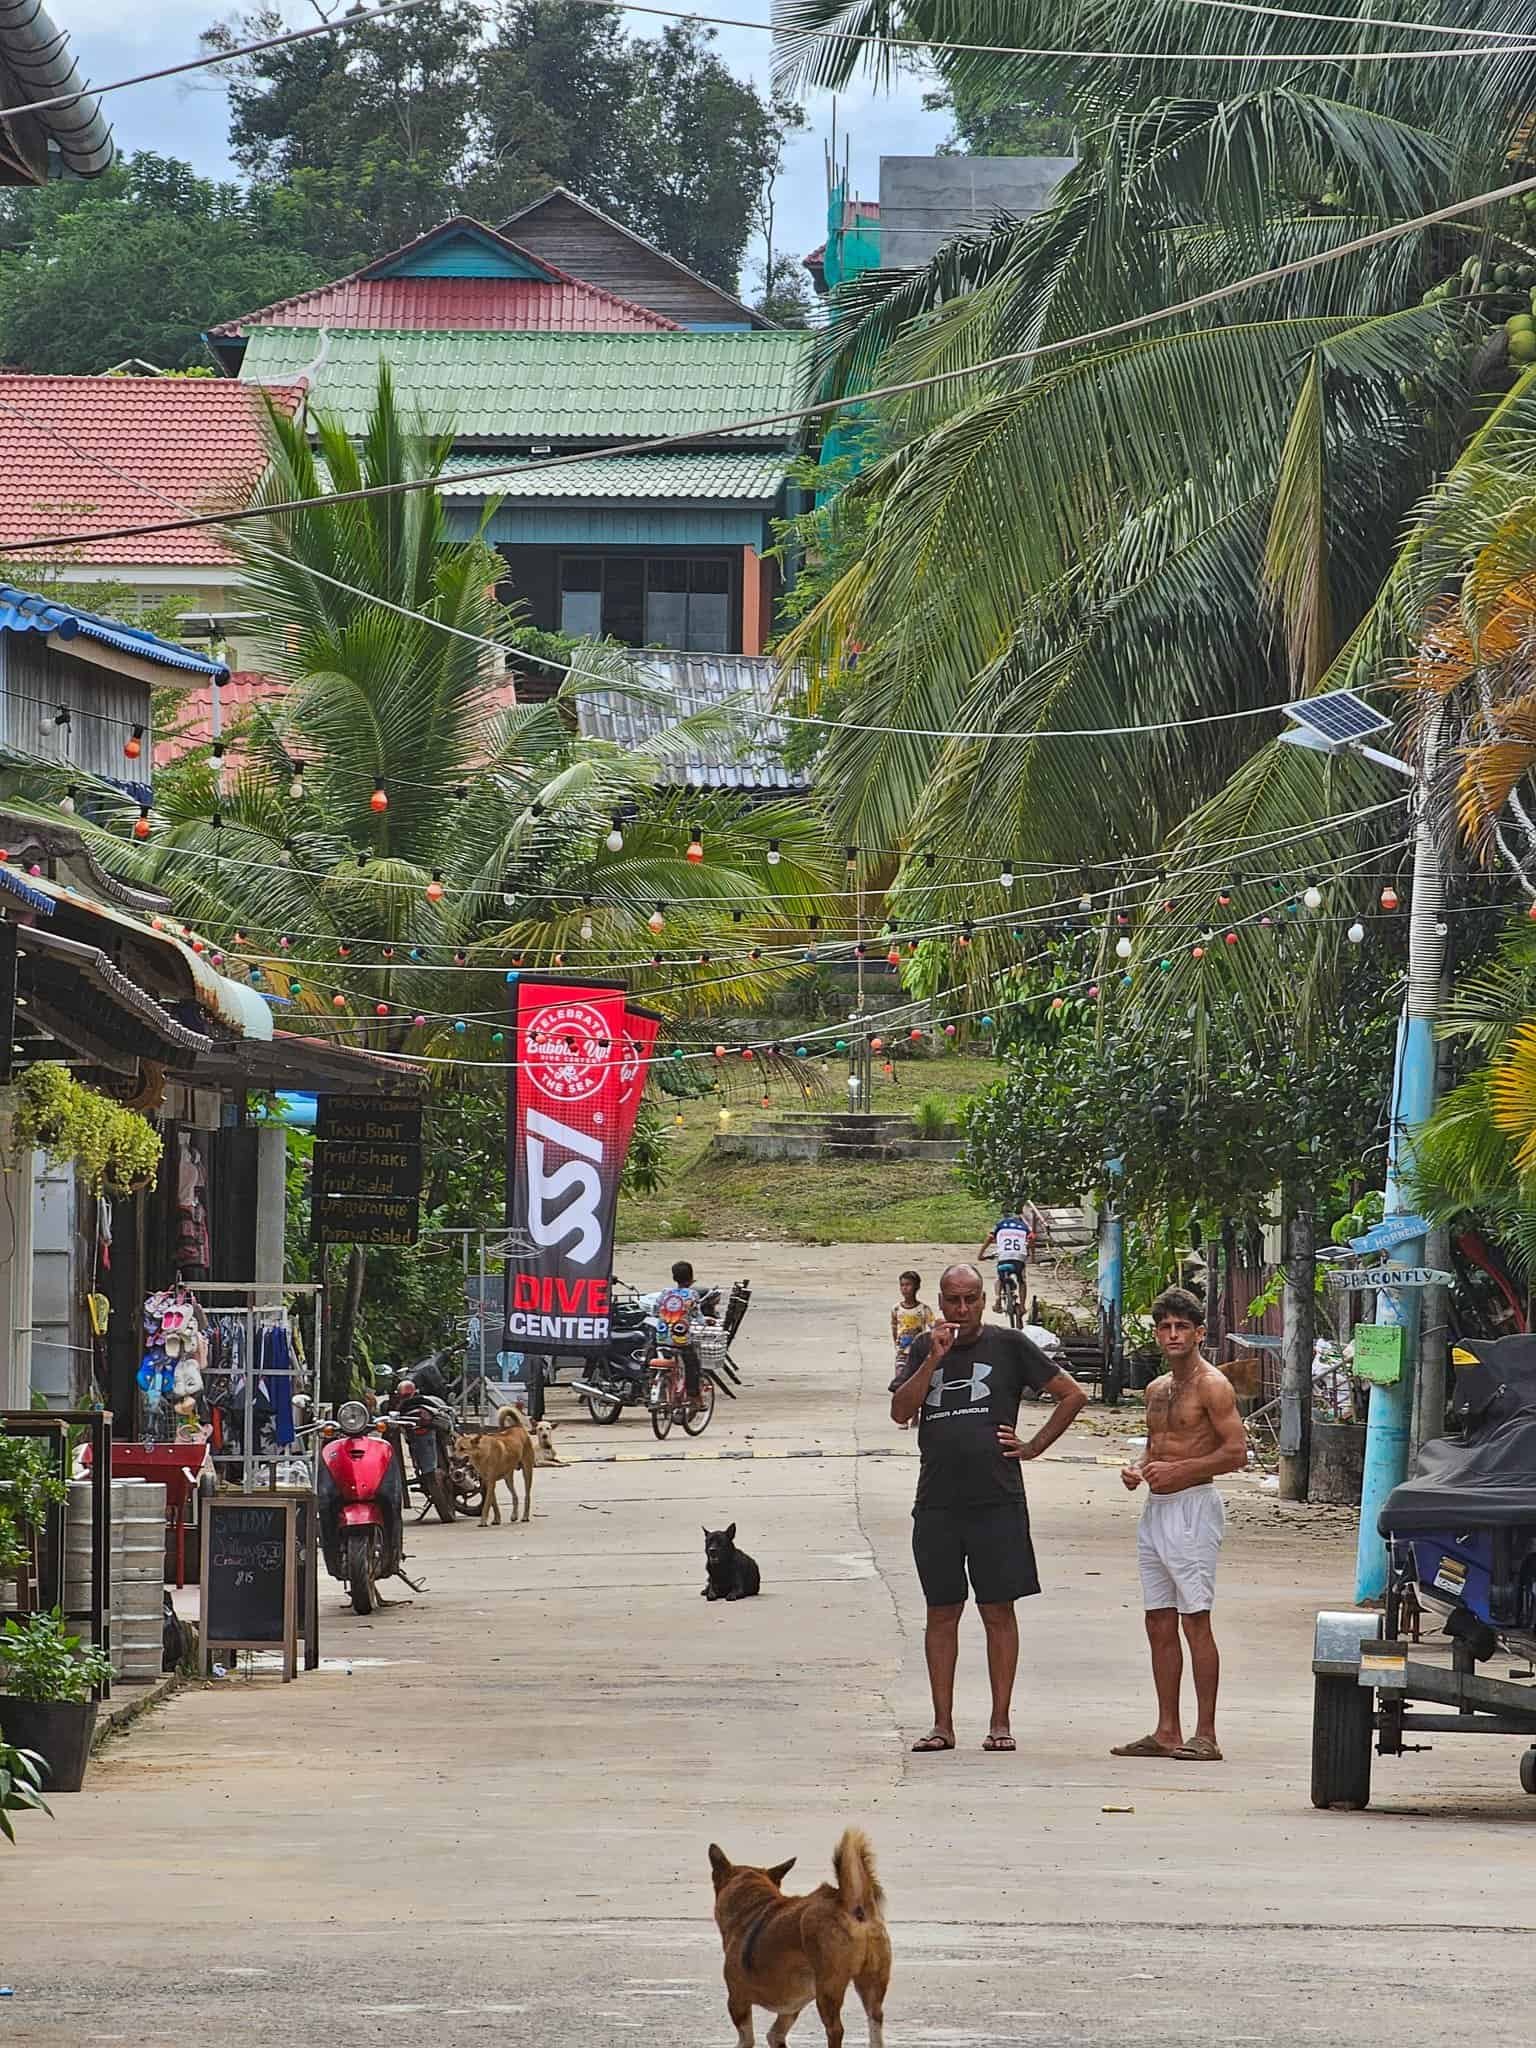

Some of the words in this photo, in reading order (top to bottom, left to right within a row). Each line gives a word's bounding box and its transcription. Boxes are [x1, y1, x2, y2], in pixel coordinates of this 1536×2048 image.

[540, 1073, 562, 1092] THE
[568, 1077, 594, 1093] SEA
[1003, 1238, 1021, 1251] 26
[513, 1273, 609, 1314] DIVE
[509, 1312, 609, 1340] CENTER
[925, 1410, 951, 1421] UNDER
[951, 1406, 989, 1416] ARMOUR
